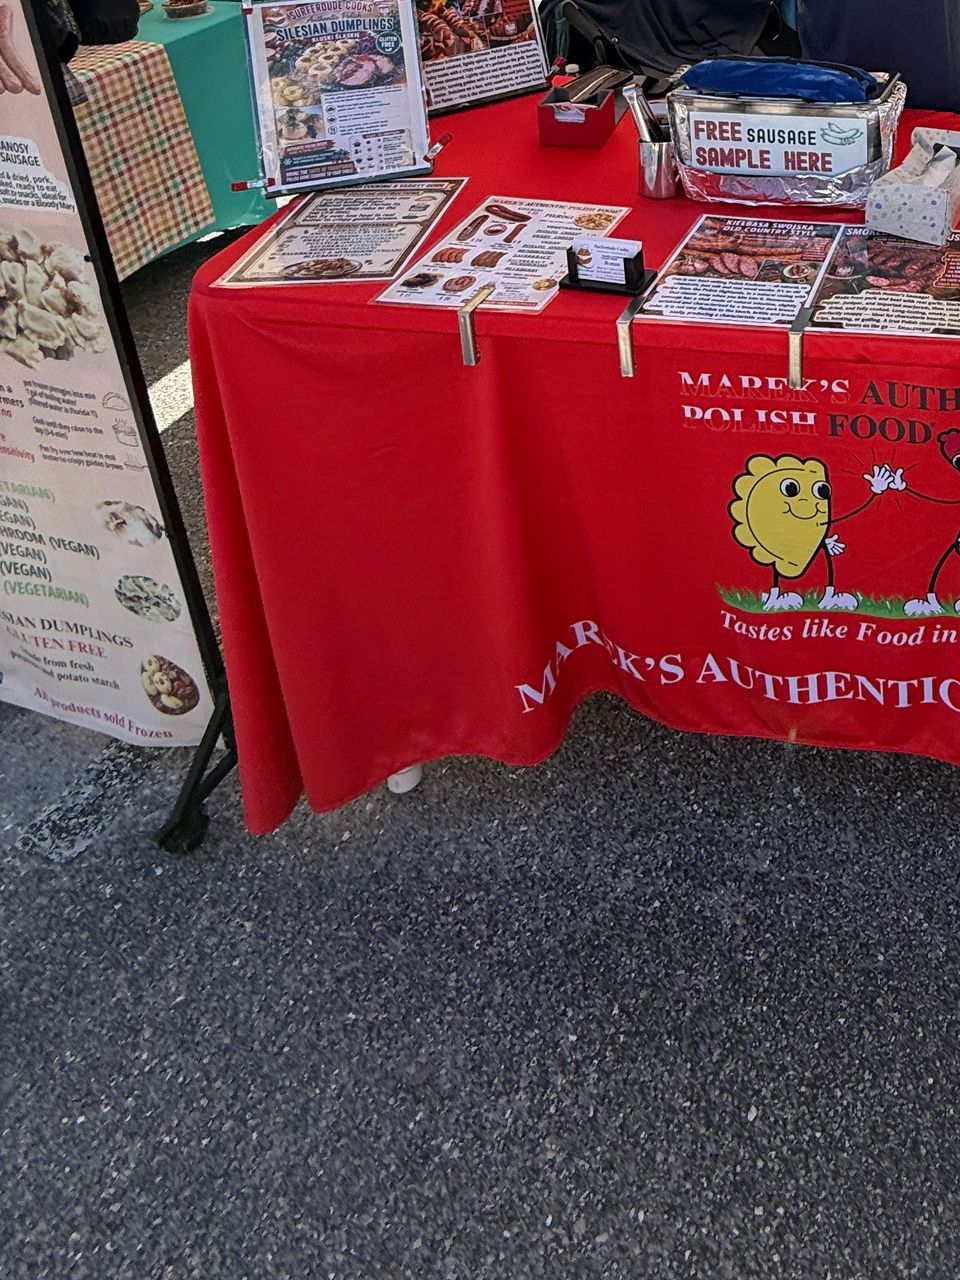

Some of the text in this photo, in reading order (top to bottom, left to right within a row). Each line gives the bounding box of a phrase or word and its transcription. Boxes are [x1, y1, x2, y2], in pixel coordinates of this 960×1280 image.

[346, 0, 375, 13] COOKS
[276, 17, 394, 42] SILESIAN DUMPLINGS
[380, 41, 396, 49] FREE
[693, 119, 818, 146] FREE SAUSAGE
[0, 152, 41, 167] SAUSAGE
[695, 147, 834, 173] SAMPLE HERE
[15, 183, 36, 193] ready
[58, 191, 67, 201] for
[526, 200, 567, 211] AUTHENTIC
[744, 226, 788, 236] COUNTRY
[790, 229, 818, 237] STYLE
[773, 222, 815, 231] SWOJSKA
[678, 371, 850, 404] MAREK'S
[681, 404, 934, 445] POLISH FOOD
[49, 536, 100, 561] (VEGAN)
[0, 560, 52, 583] (VEGAN)
[4, 579, 89, 609] (VEGETARIAN)
[6, 625, 107, 659] GLUTEN FREE
[40, 618, 134, 649] DUMPLINGS
[720, 610, 793, 642] Tastes
[801, 616, 848, 641] like
[855, 620, 926, 650] Food
[931, 625, 959, 645] in
[43, 656, 67, 669] from
[69, 660, 95, 672] fresh
[514, 618, 687, 714] MAREK'S
[57, 672, 121, 690] potato starch
[51, 699, 174, 739] products sold Frozen
